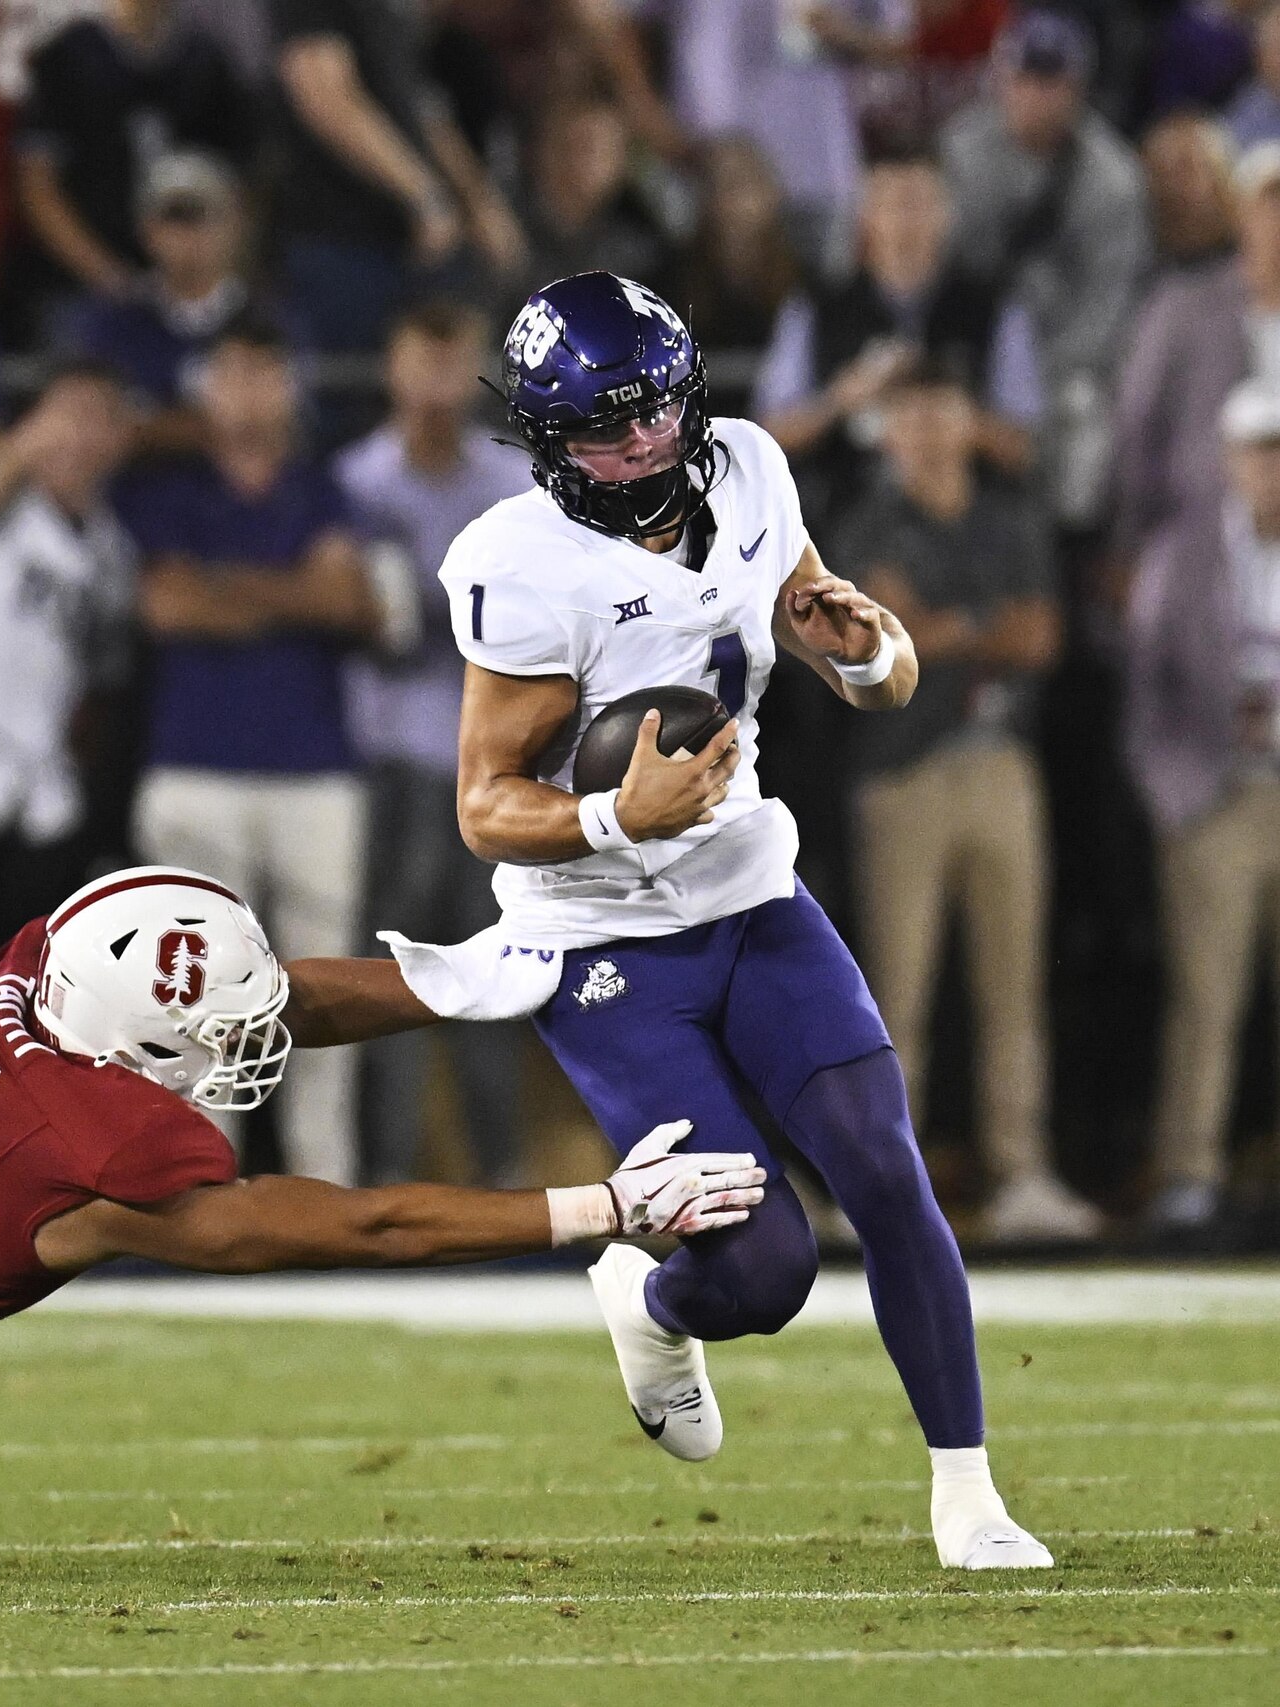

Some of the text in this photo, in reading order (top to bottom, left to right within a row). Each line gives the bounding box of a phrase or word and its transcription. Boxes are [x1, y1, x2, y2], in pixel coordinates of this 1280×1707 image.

[607, 382, 642, 405] TCU
[612, 593, 652, 625] XII
[700, 588, 717, 605] TCU
[468, 583, 486, 643] 1
[700, 625, 751, 719] 1
